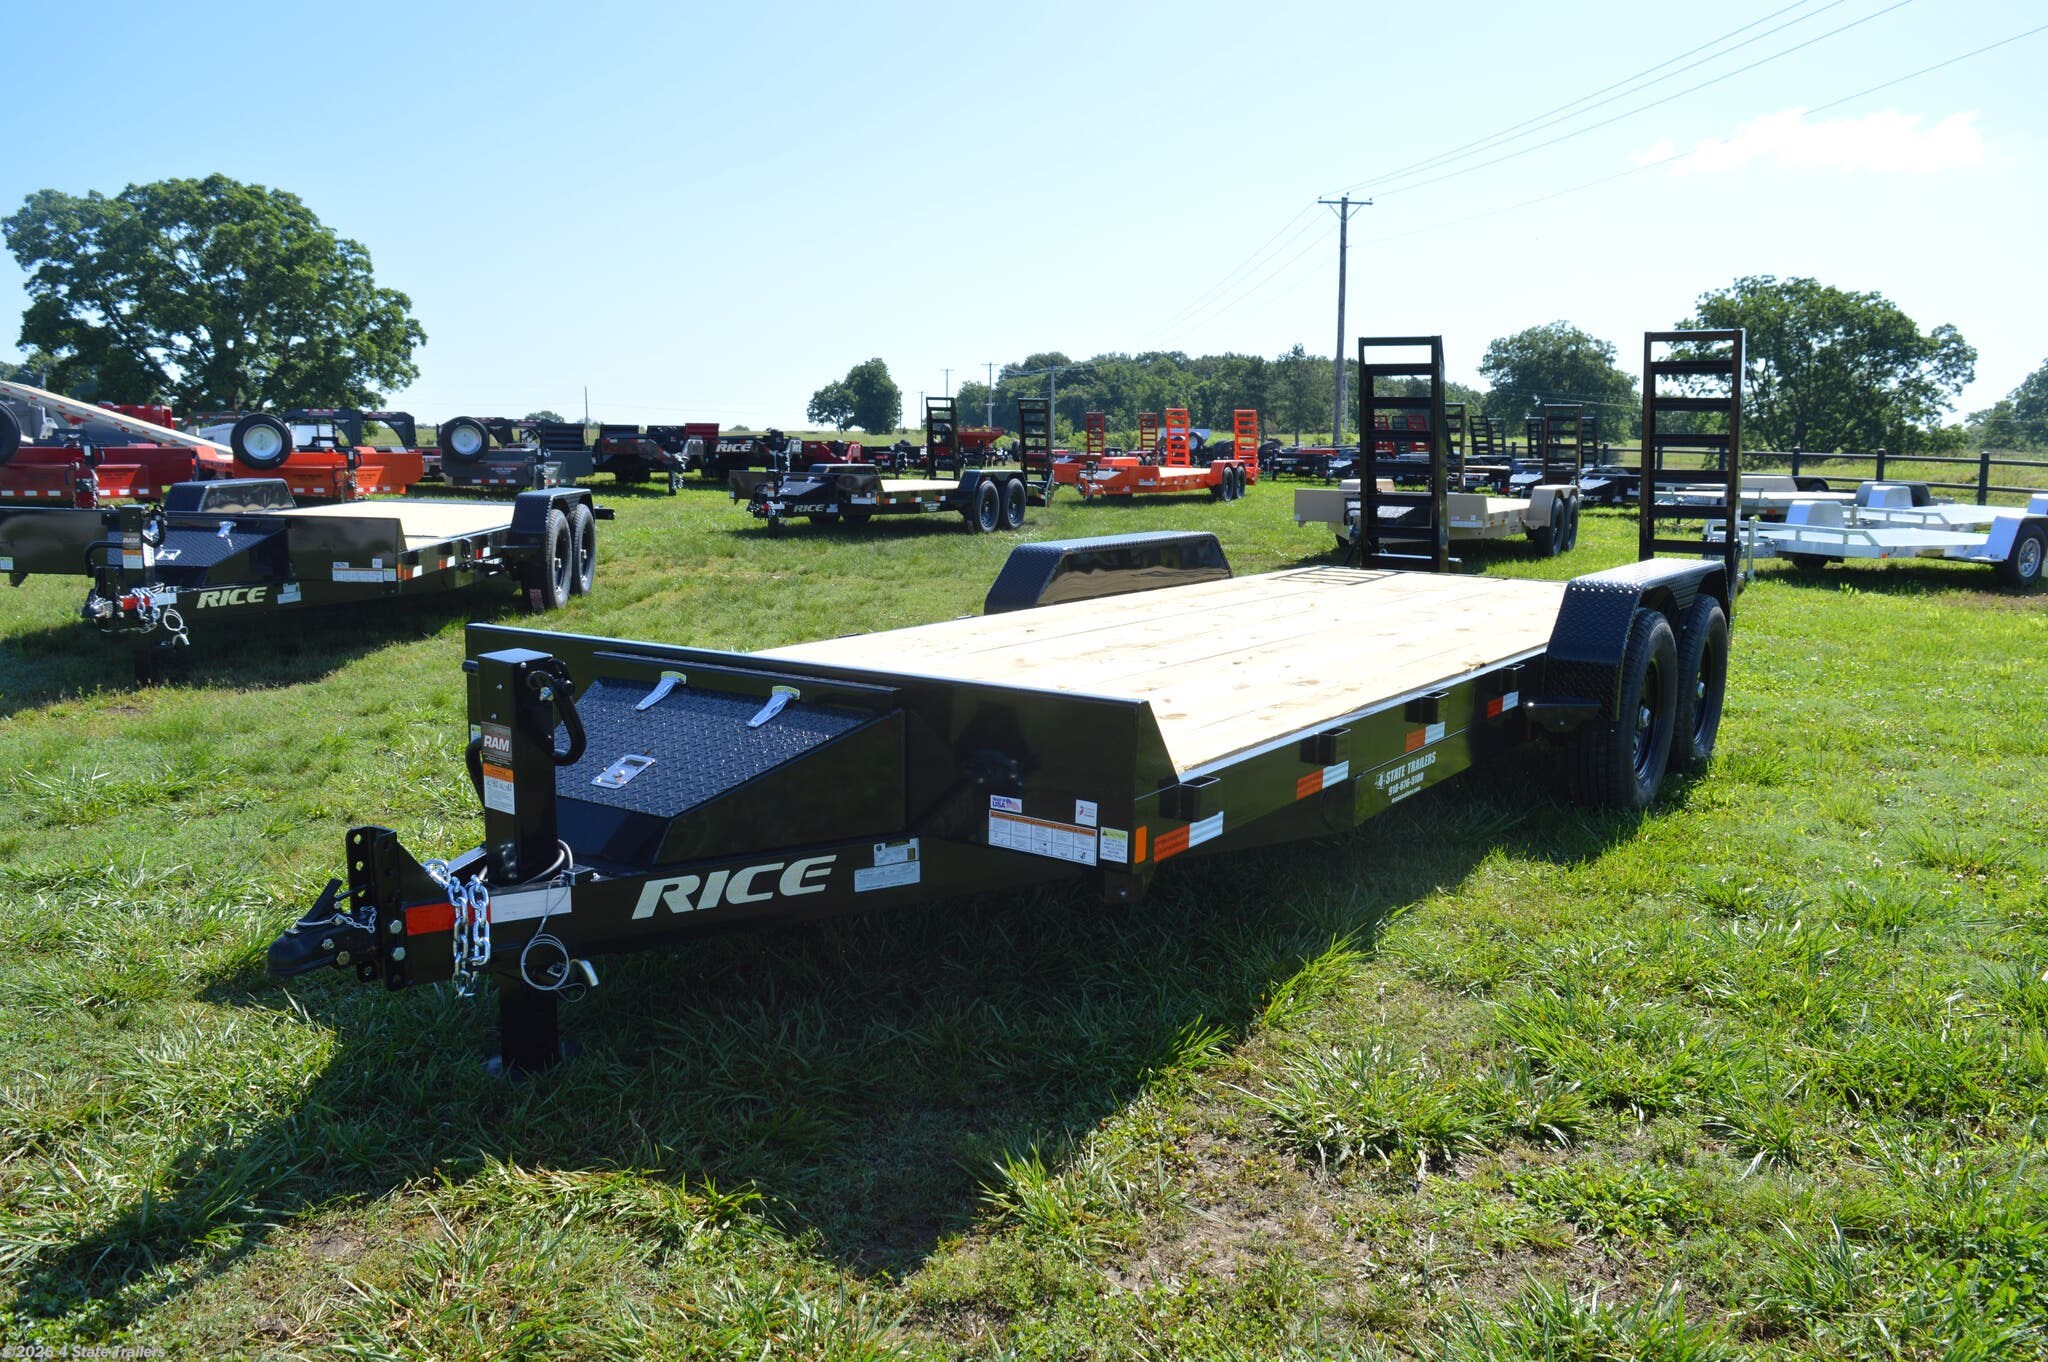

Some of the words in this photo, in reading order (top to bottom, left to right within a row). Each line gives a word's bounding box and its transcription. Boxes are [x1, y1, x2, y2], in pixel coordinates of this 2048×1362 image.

[715, 443, 752, 453] RICE
[794, 504, 825, 513] RICE
[196, 586, 268, 609] RICE
[483, 735, 510, 753] RAM
[1385, 764, 1406, 785] STATE
[1407, 751, 1437, 774] TRAILERS
[992, 801, 1006, 809] USA
[631, 854, 837, 920] RICE
